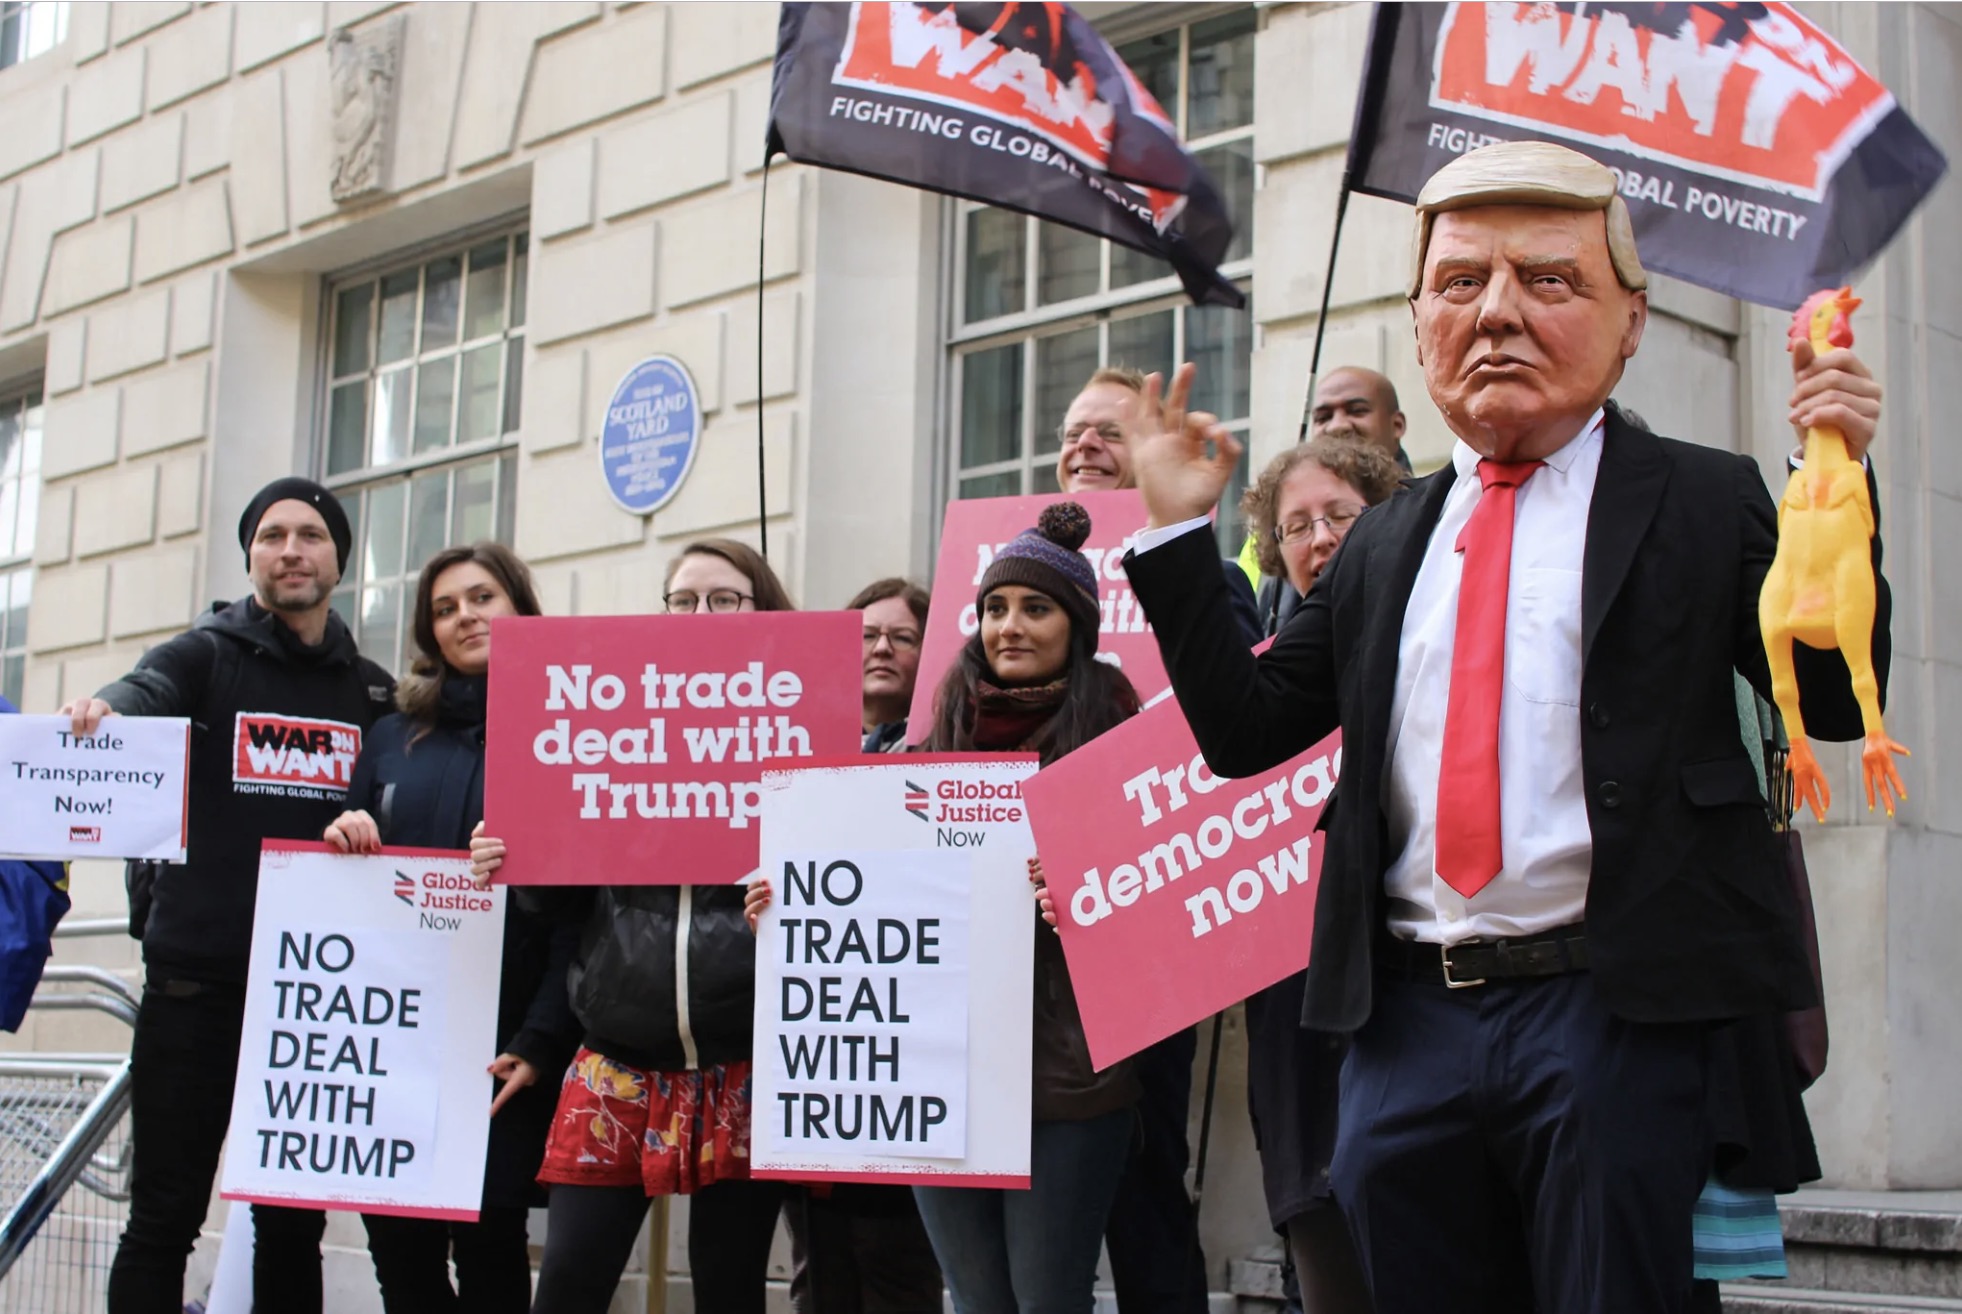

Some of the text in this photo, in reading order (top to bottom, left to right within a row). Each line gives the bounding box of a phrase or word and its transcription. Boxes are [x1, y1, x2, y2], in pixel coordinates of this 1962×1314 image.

[889, 2, 1112, 154] WAN
[1485, 2, 1833, 151] WANT
[830, 96, 962, 139] FIGHTING
[969, 126, 1084, 178] GLOBAL
[1607, 166, 1678, 209] OBAL
[1684, 186, 1808, 241] POVERTY
[609, 391, 689, 427] SCOTLAND
[626, 418, 670, 442] YARD
[545, 661, 803, 711] No trade
[57, 731, 123, 750] Trade
[247, 722, 354, 755] WAR ON
[533, 716, 813, 765] deal with
[12, 762, 165, 789] Transparency
[245, 741, 355, 783] WANT
[55, 796, 113, 815] Now!
[233, 783, 286, 797] FIGHTING
[287, 787, 324, 801] GLOBAL
[572, 773, 762, 829] Trump
[936, 779, 1022, 800] Global
[936, 803, 1023, 823] Justice
[937, 827, 986, 847] Now
[1070, 746, 1343, 927] democra
[420, 892, 493, 912] Justice
[422, 872, 493, 892] Glob
[782, 859, 863, 906] NO
[1185, 836, 1312, 938] now
[420, 912, 462, 931] Now
[780, 918, 940, 964] TRADE
[278, 931, 355, 972] NO
[274, 980, 421, 1028] TRADE
[781, 977, 910, 1023] DEAL
[268, 1030, 388, 1076] DEAL
[779, 1034, 899, 1082] WITH
[264, 1079, 376, 1125] WITH
[777, 1092, 947, 1142] TRUMP
[257, 1129, 415, 1178] TRUMP
